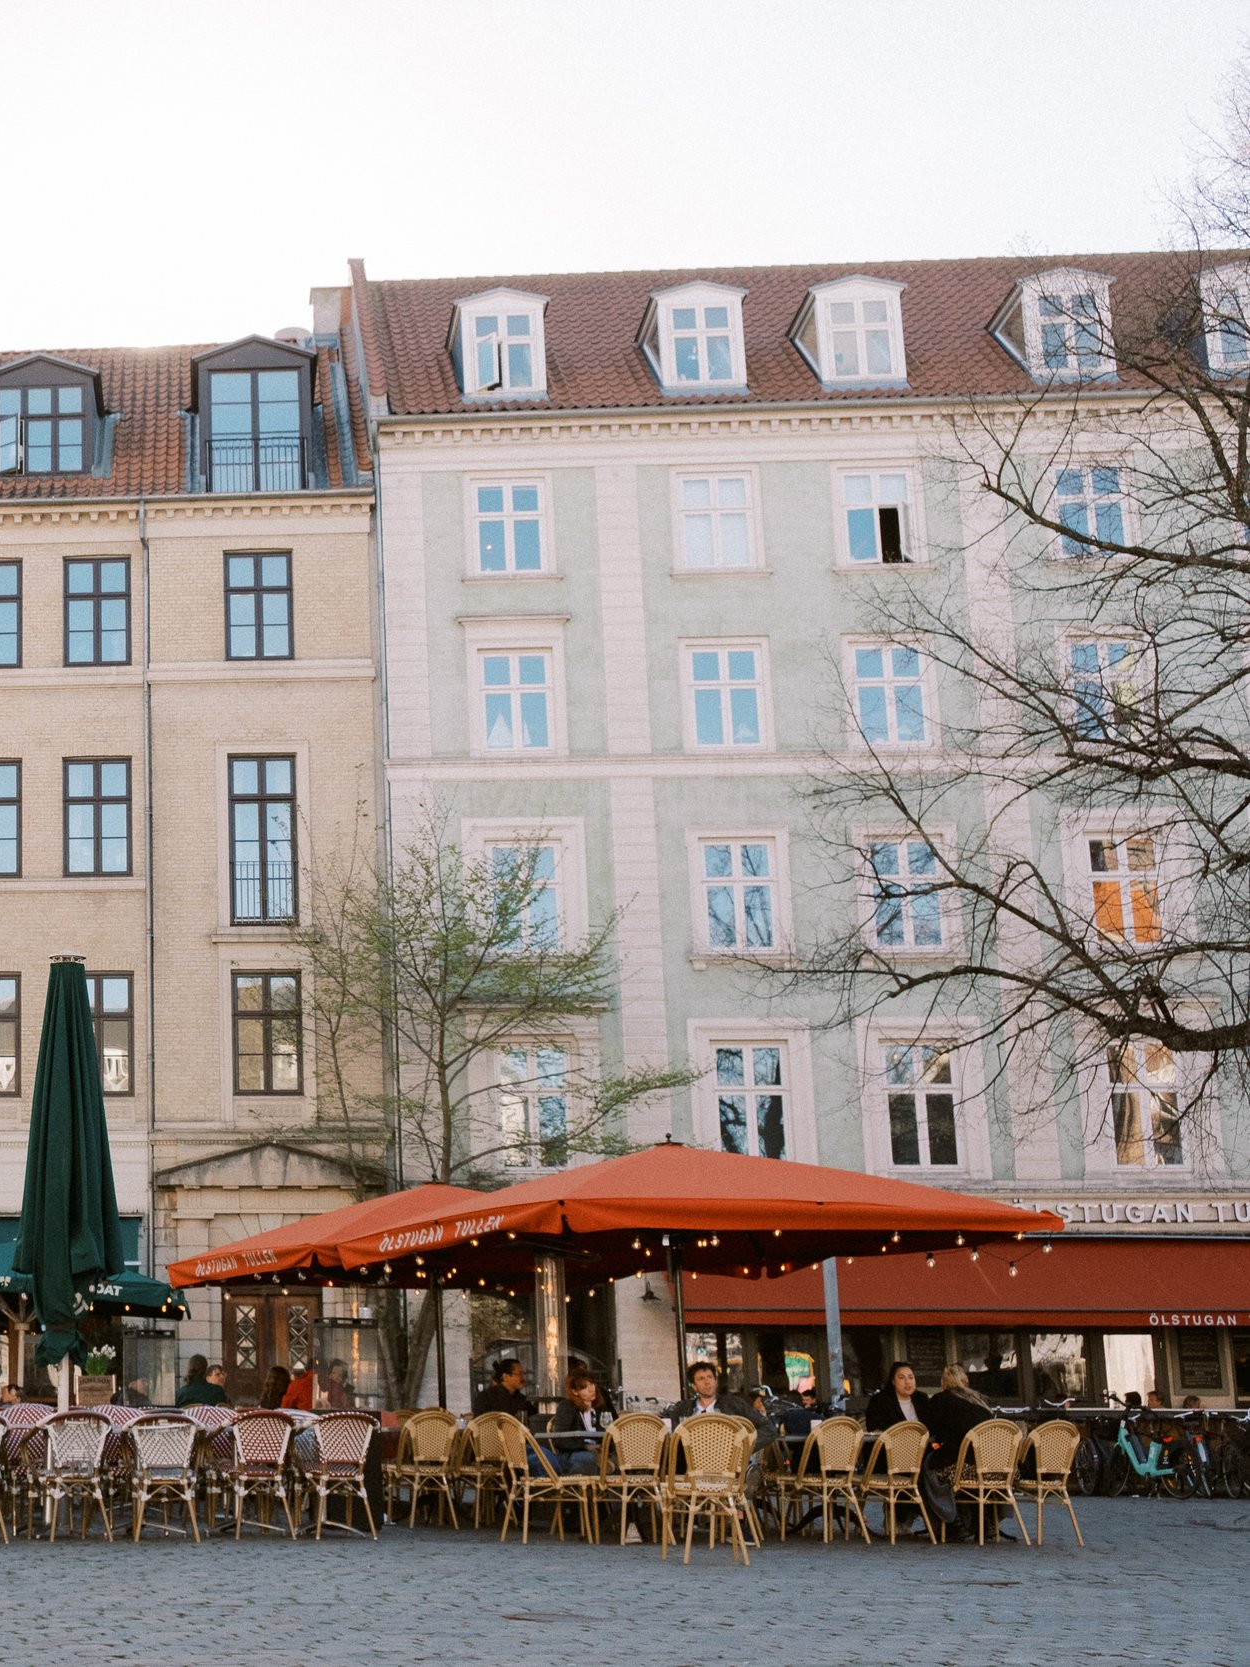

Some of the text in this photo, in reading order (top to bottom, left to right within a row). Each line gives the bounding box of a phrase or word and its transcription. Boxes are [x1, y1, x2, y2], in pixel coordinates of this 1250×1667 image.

[1012, 1198, 1195, 1223] STUGAN
[378, 1215, 504, 1253] ÖLSTUGAN TULLEN
[195, 1249, 278, 1278] ÖLSTUGAN TULLEN
[96, 1283, 123, 1297] OAT
[1149, 1312, 1237, 1325] ÖLSTUGAN
